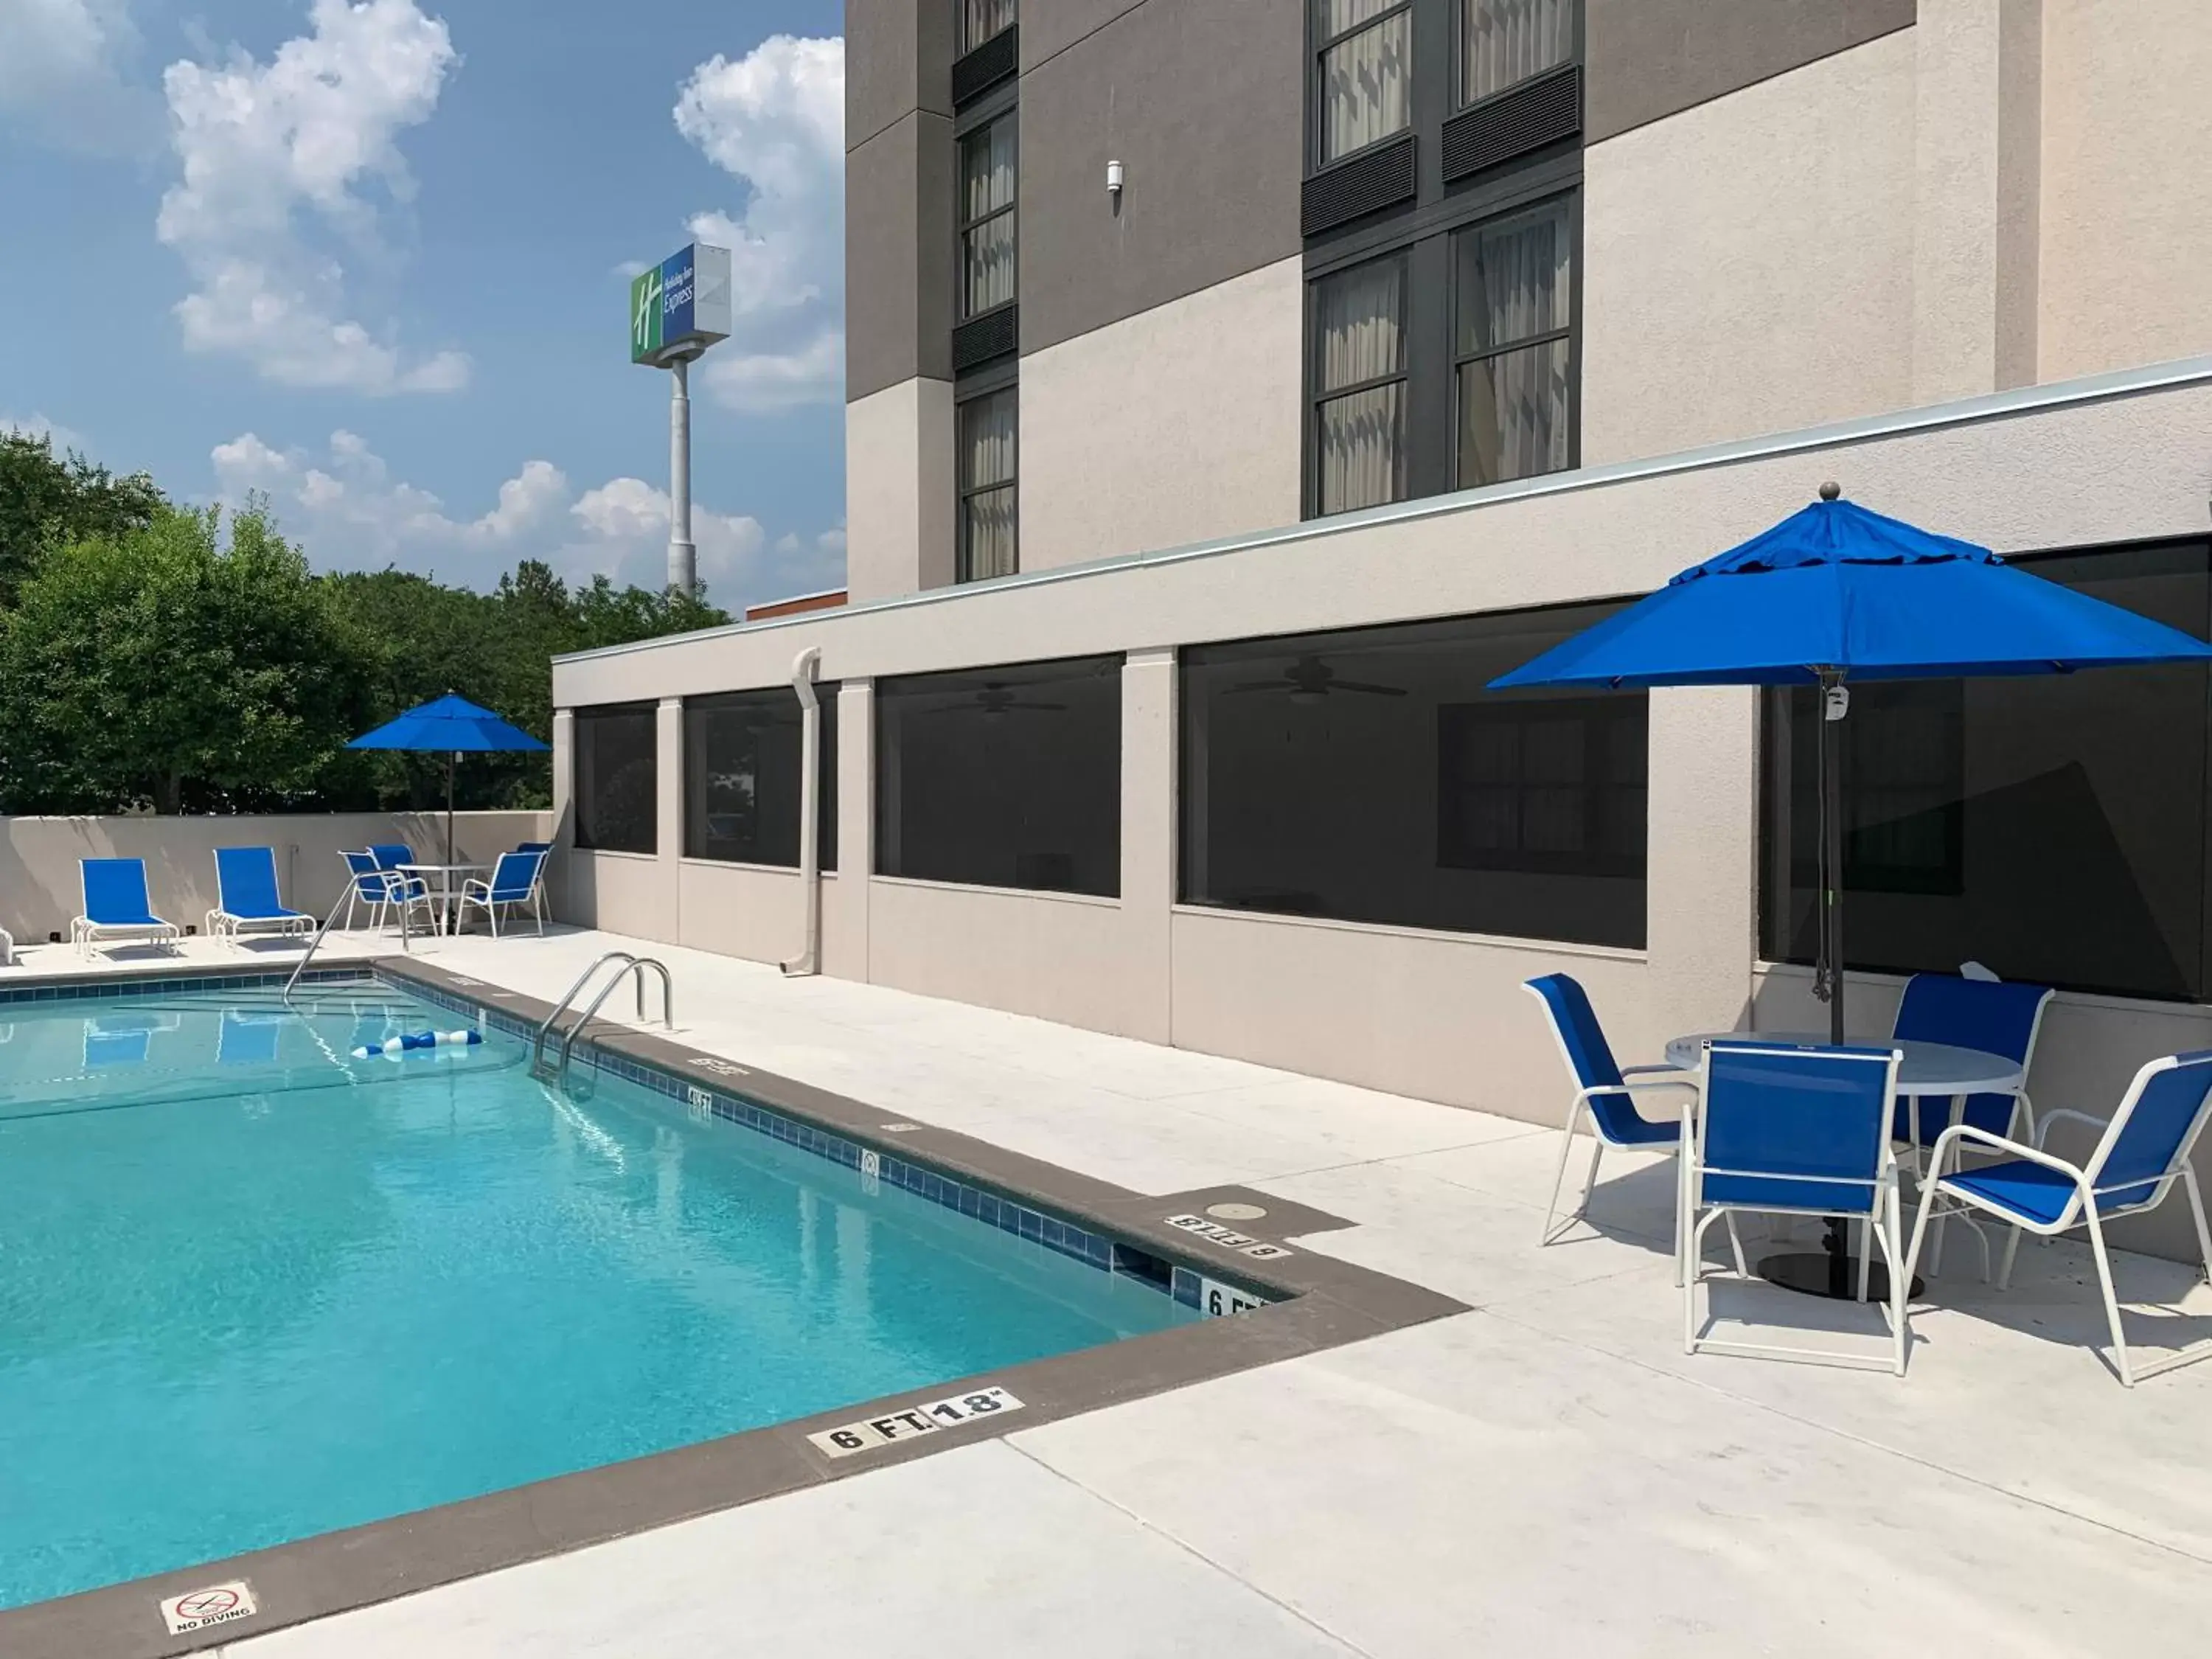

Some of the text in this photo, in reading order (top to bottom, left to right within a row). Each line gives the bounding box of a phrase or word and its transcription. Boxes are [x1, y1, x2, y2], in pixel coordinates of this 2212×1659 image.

[664, 284, 693, 315] Express
[1209, 1290, 1222, 1316] 6
[830, 1431, 863, 1449] 6
[177, 1607, 250, 1632] NO DIVING
